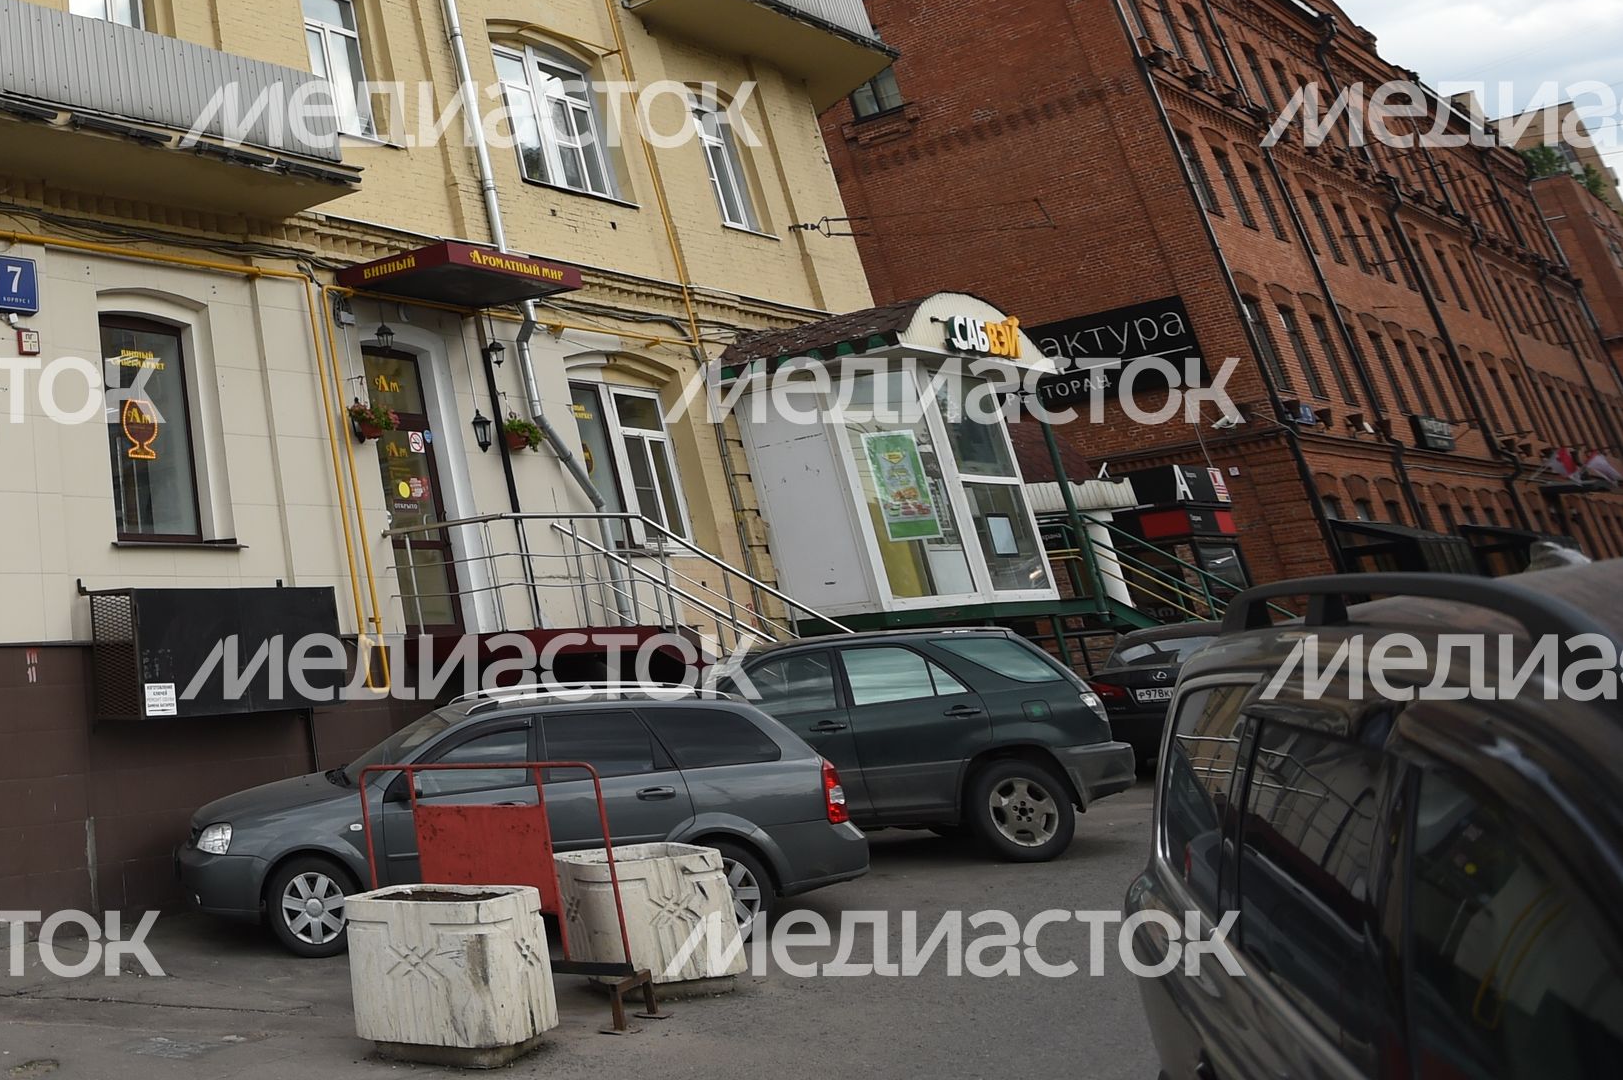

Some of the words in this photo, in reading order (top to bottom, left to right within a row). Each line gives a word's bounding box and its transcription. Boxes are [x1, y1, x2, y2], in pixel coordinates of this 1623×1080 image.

[7, 265, 22, 293] 7
[363, 253, 416, 280] ВИННЫЙ
[1005, 375, 1113, 408] РЕТОРАН
